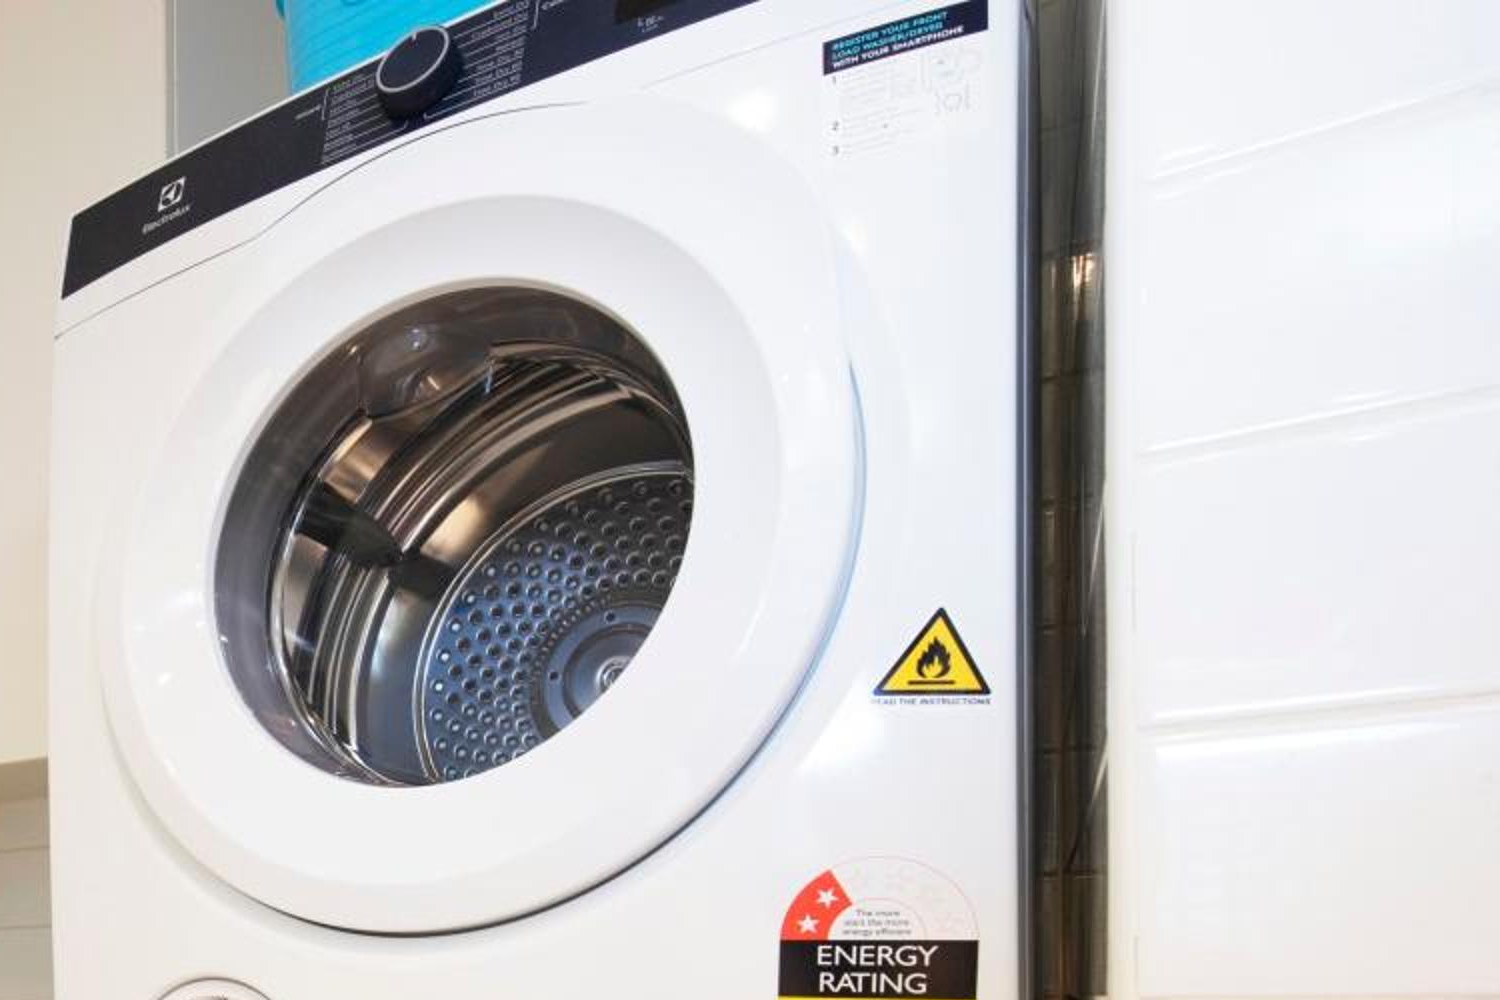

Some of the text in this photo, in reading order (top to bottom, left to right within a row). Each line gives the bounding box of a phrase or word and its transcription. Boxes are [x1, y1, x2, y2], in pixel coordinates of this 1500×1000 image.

[831, 11, 948, 50] REGISTER YOUR FRONT
[832, 44, 860, 60] LOAD
[833, 26, 964, 69] WITH YOUR SMARTPHONE
[142, 203, 191, 234] Electrolux
[816, 944, 939, 967] ENERGY
[819, 972, 928, 995] RATING
